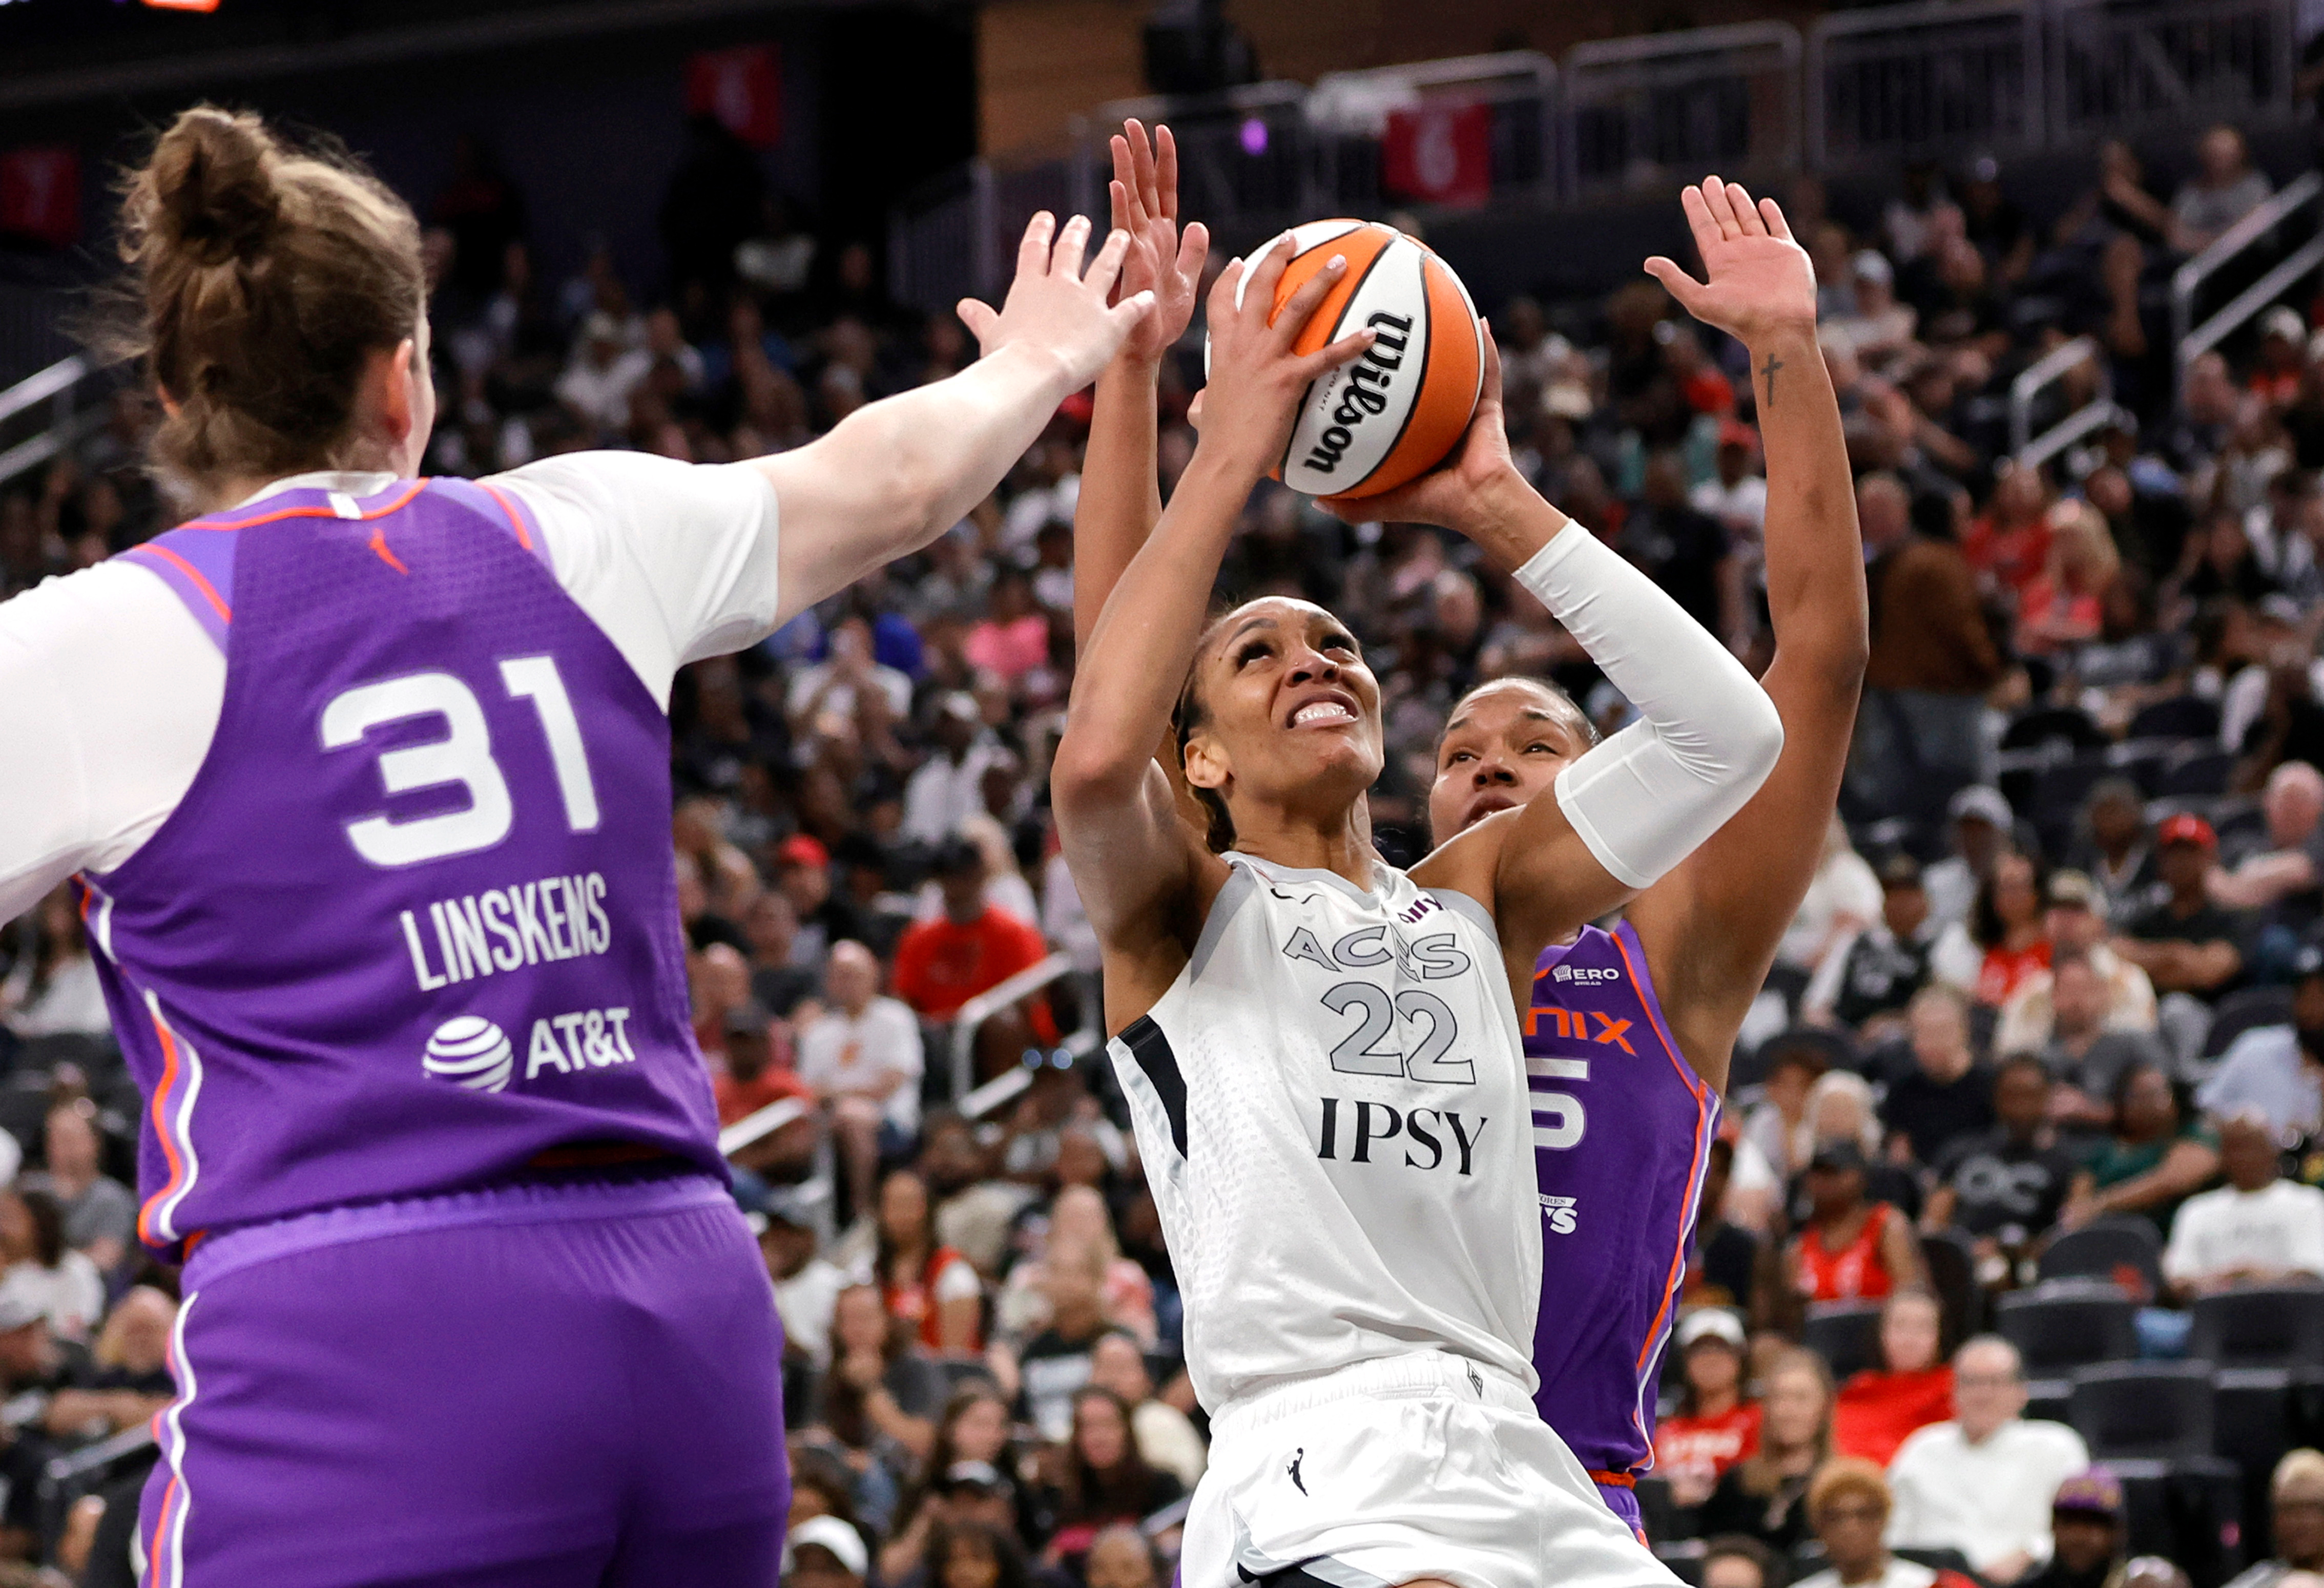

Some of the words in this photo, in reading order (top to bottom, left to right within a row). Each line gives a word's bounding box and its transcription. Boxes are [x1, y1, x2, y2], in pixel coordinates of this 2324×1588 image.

[1303, 309, 1415, 474] Wilson
[320, 655, 600, 867] 31
[400, 872, 611, 992] LINSKENS
[1282, 922, 1471, 983] ACES
[526, 1007, 636, 1079] AT&T
[1320, 981, 1477, 1085] 22
[1524, 1006, 1638, 1057] nix
[1317, 1097, 1488, 1176] IPSY
[1539, 1195, 1567, 1205] ORES
